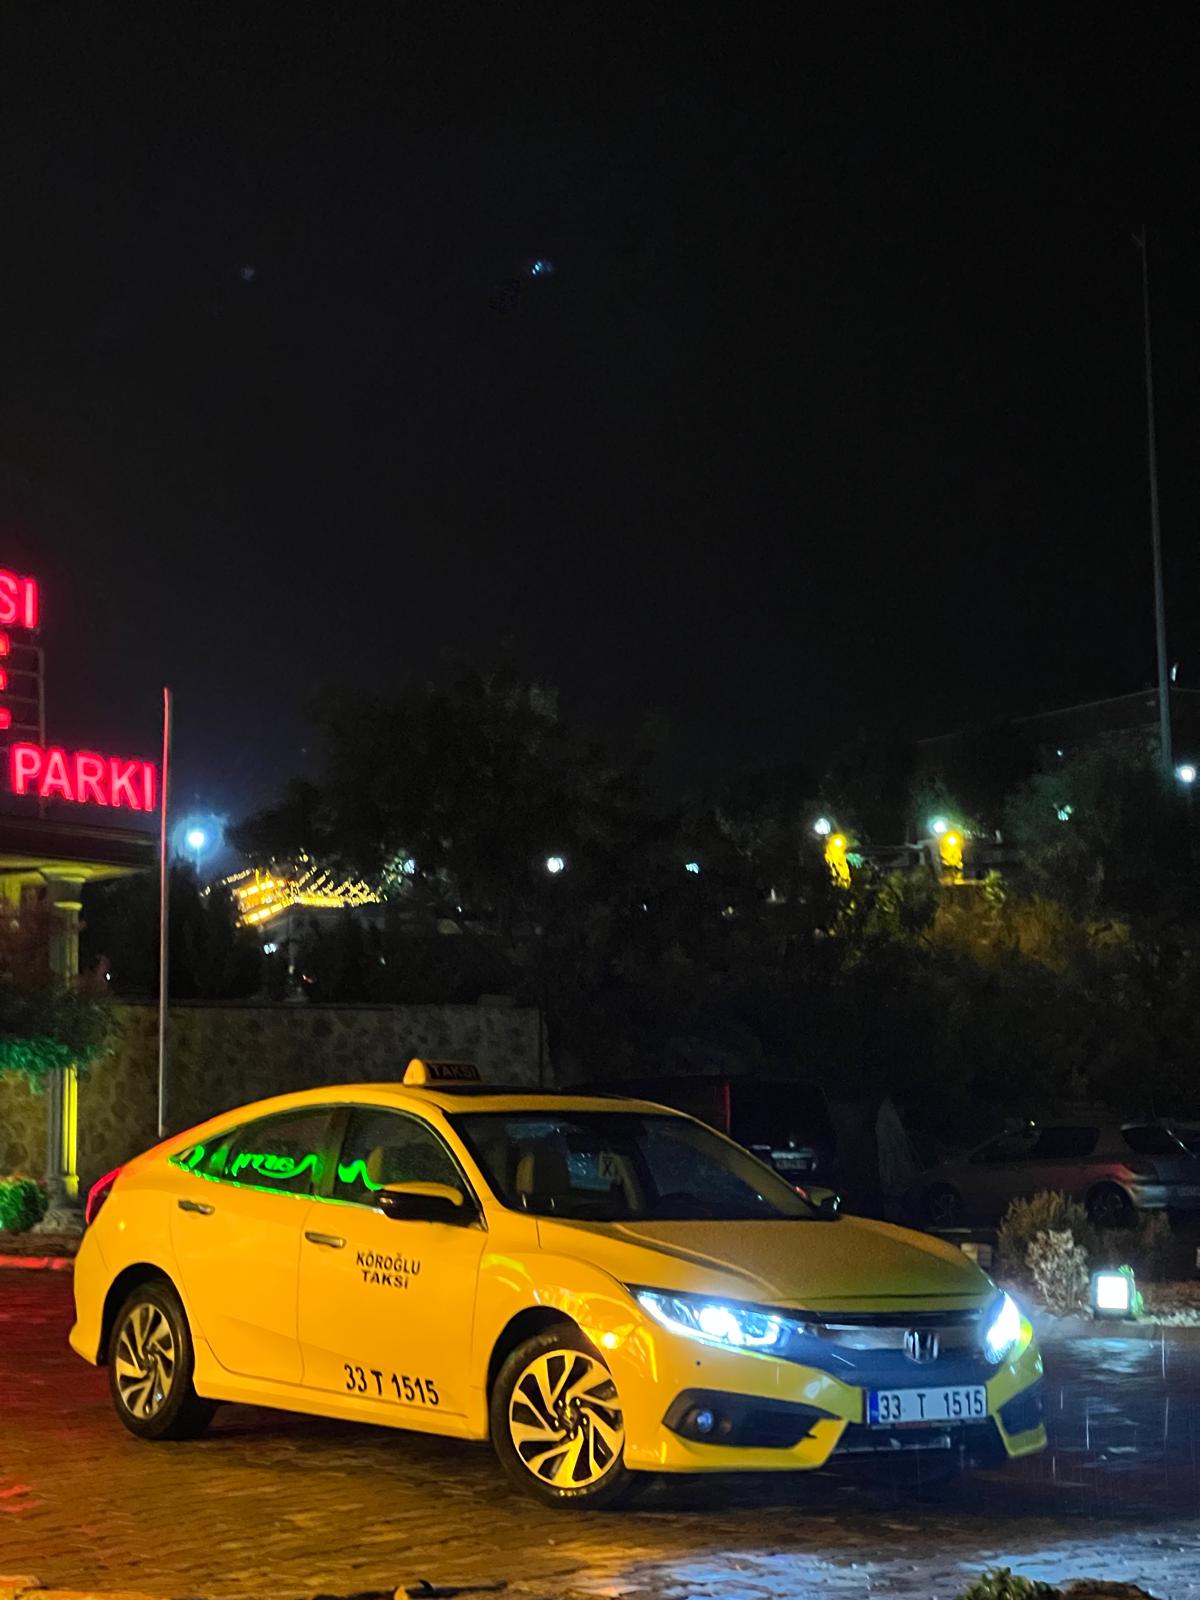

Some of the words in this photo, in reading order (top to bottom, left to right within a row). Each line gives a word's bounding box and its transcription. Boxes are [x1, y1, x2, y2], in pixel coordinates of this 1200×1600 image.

[11, 742, 156, 812] PARKI
[344, 1363, 367, 1392] 33
[370, 1369, 382, 1396] T
[391, 1372, 439, 1406] 1515
[880, 1395, 901, 1420] 33
[917, 1393, 927, 1418] T
[943, 1389, 984, 1416] 1515
